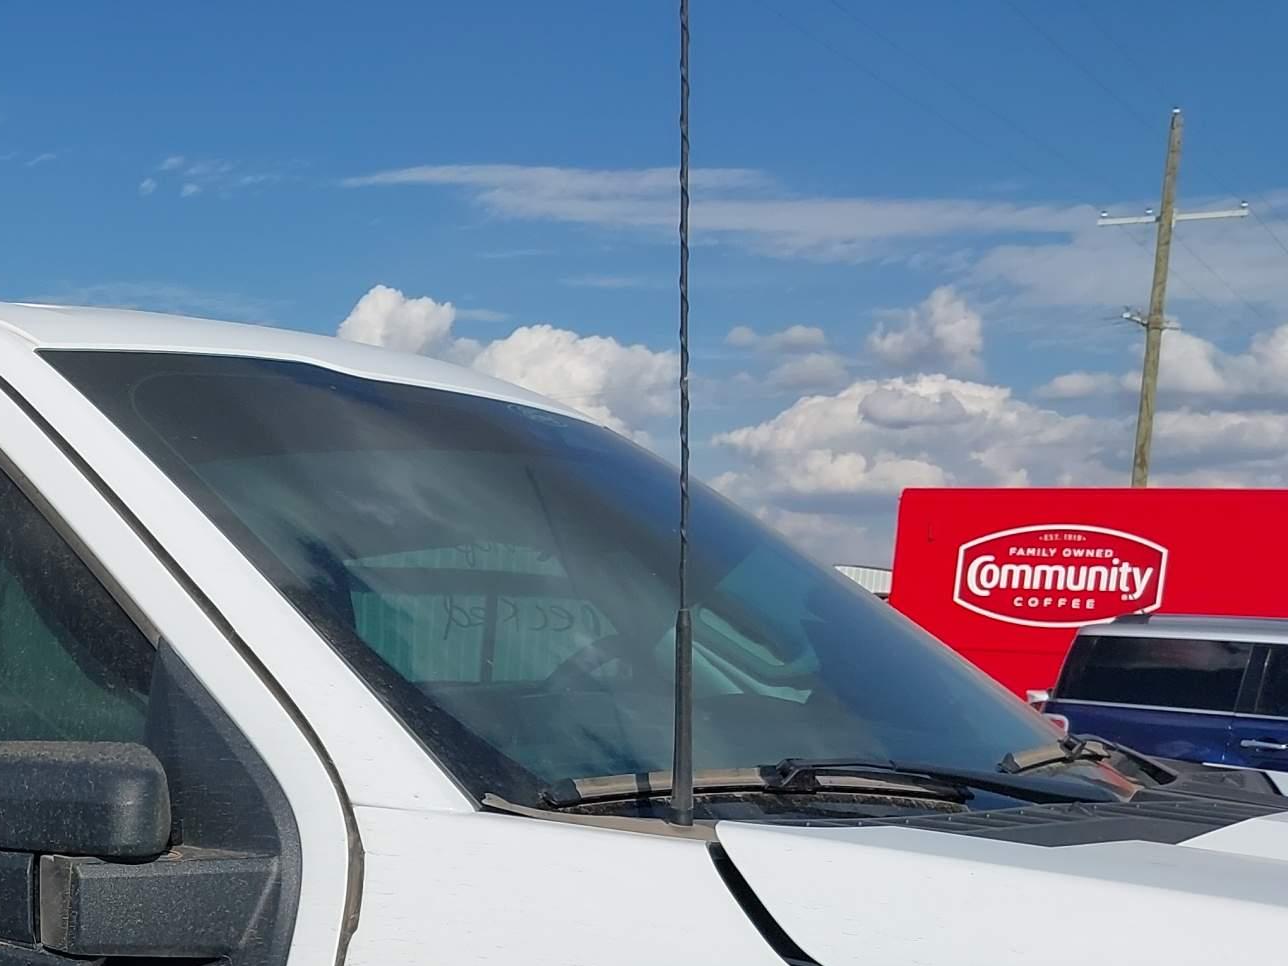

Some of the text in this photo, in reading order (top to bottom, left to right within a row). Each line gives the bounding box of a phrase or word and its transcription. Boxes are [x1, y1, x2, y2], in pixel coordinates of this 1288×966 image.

[1009, 547, 1114, 559] FAMILY OWNED
[967, 555, 1153, 601] Community
[1013, 596, 1096, 609] COFFEE
